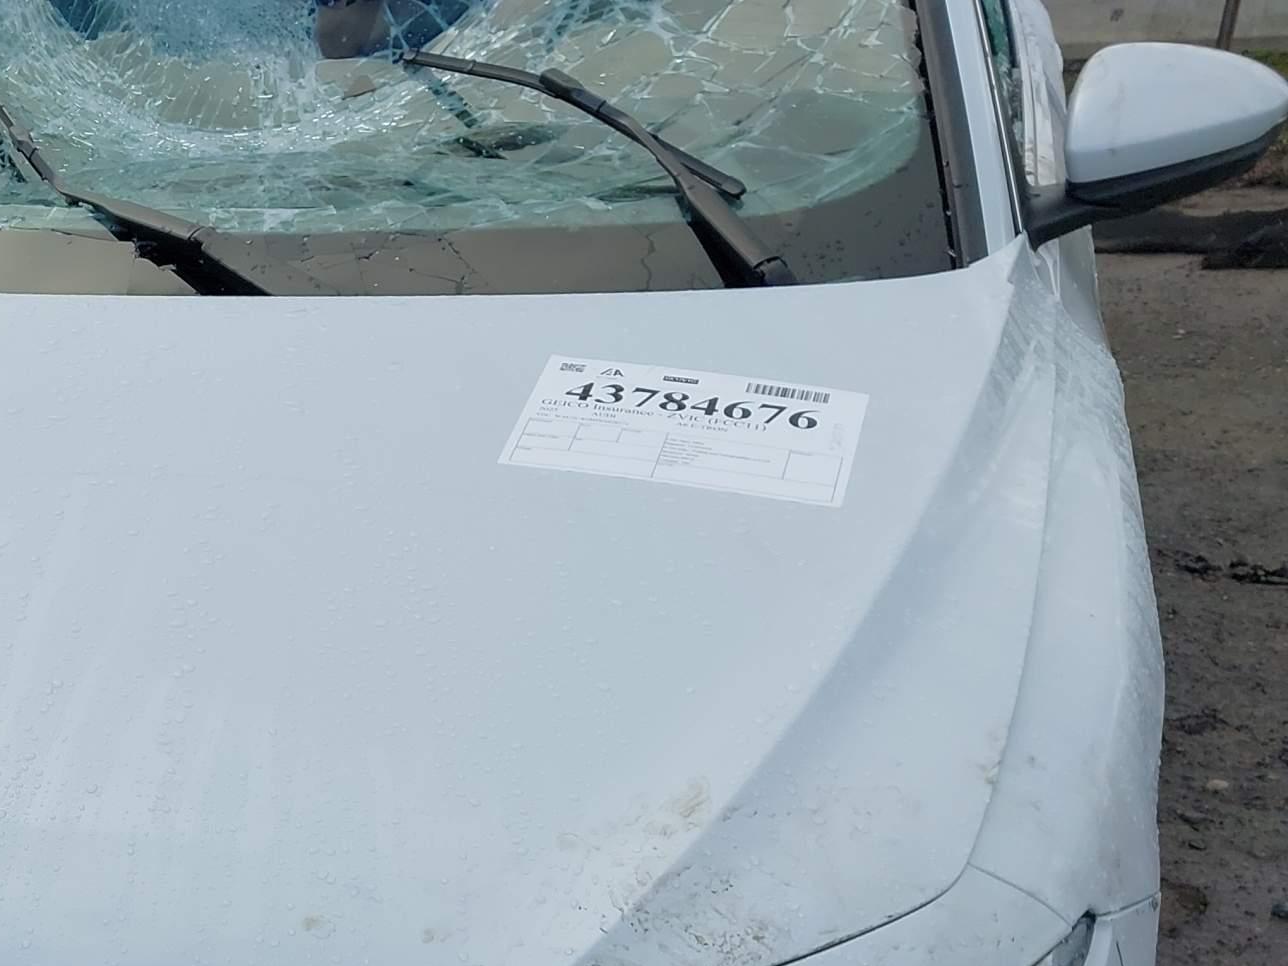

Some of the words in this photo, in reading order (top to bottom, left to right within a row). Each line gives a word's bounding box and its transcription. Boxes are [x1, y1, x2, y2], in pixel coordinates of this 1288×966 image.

[541, 398, 589, 408] GEICO
[593, 404, 655, 417] Insurance
[565, 382, 822, 430] 43784676
